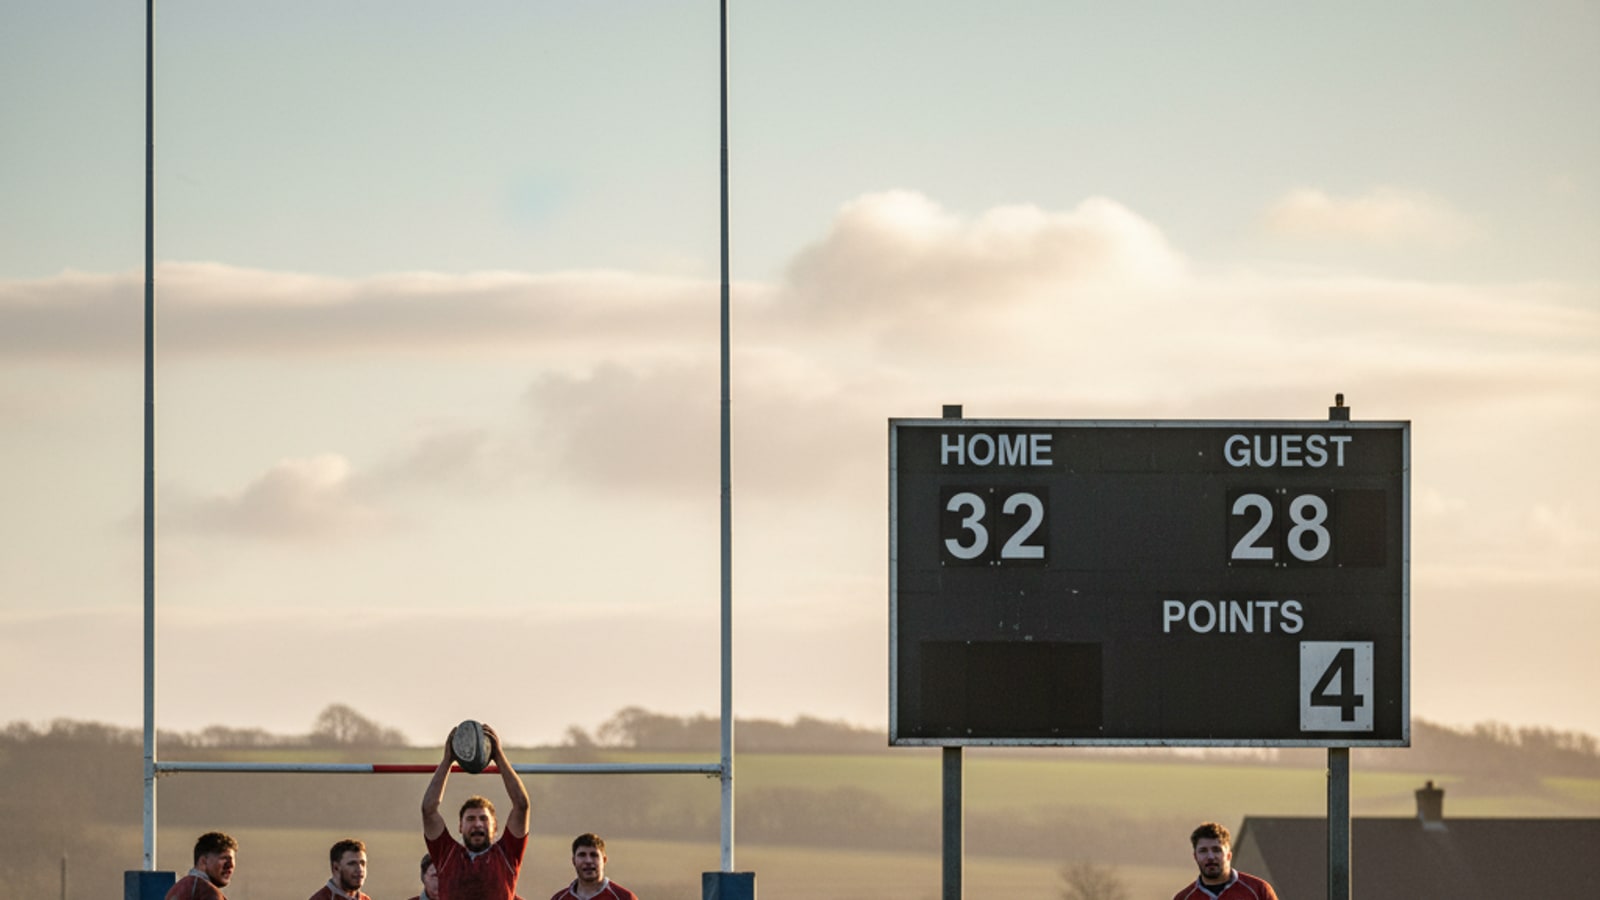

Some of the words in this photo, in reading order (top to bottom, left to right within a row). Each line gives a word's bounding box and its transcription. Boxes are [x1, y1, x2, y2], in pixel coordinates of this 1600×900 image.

[941, 433, 1053, 466] HOME
[1223, 434, 1353, 468] GUEST
[944, 492, 1045, 560] 32
[1231, 493, 1331, 562] 28
[1163, 599, 1304, 634] POINTS
[1309, 647, 1365, 723] 4
